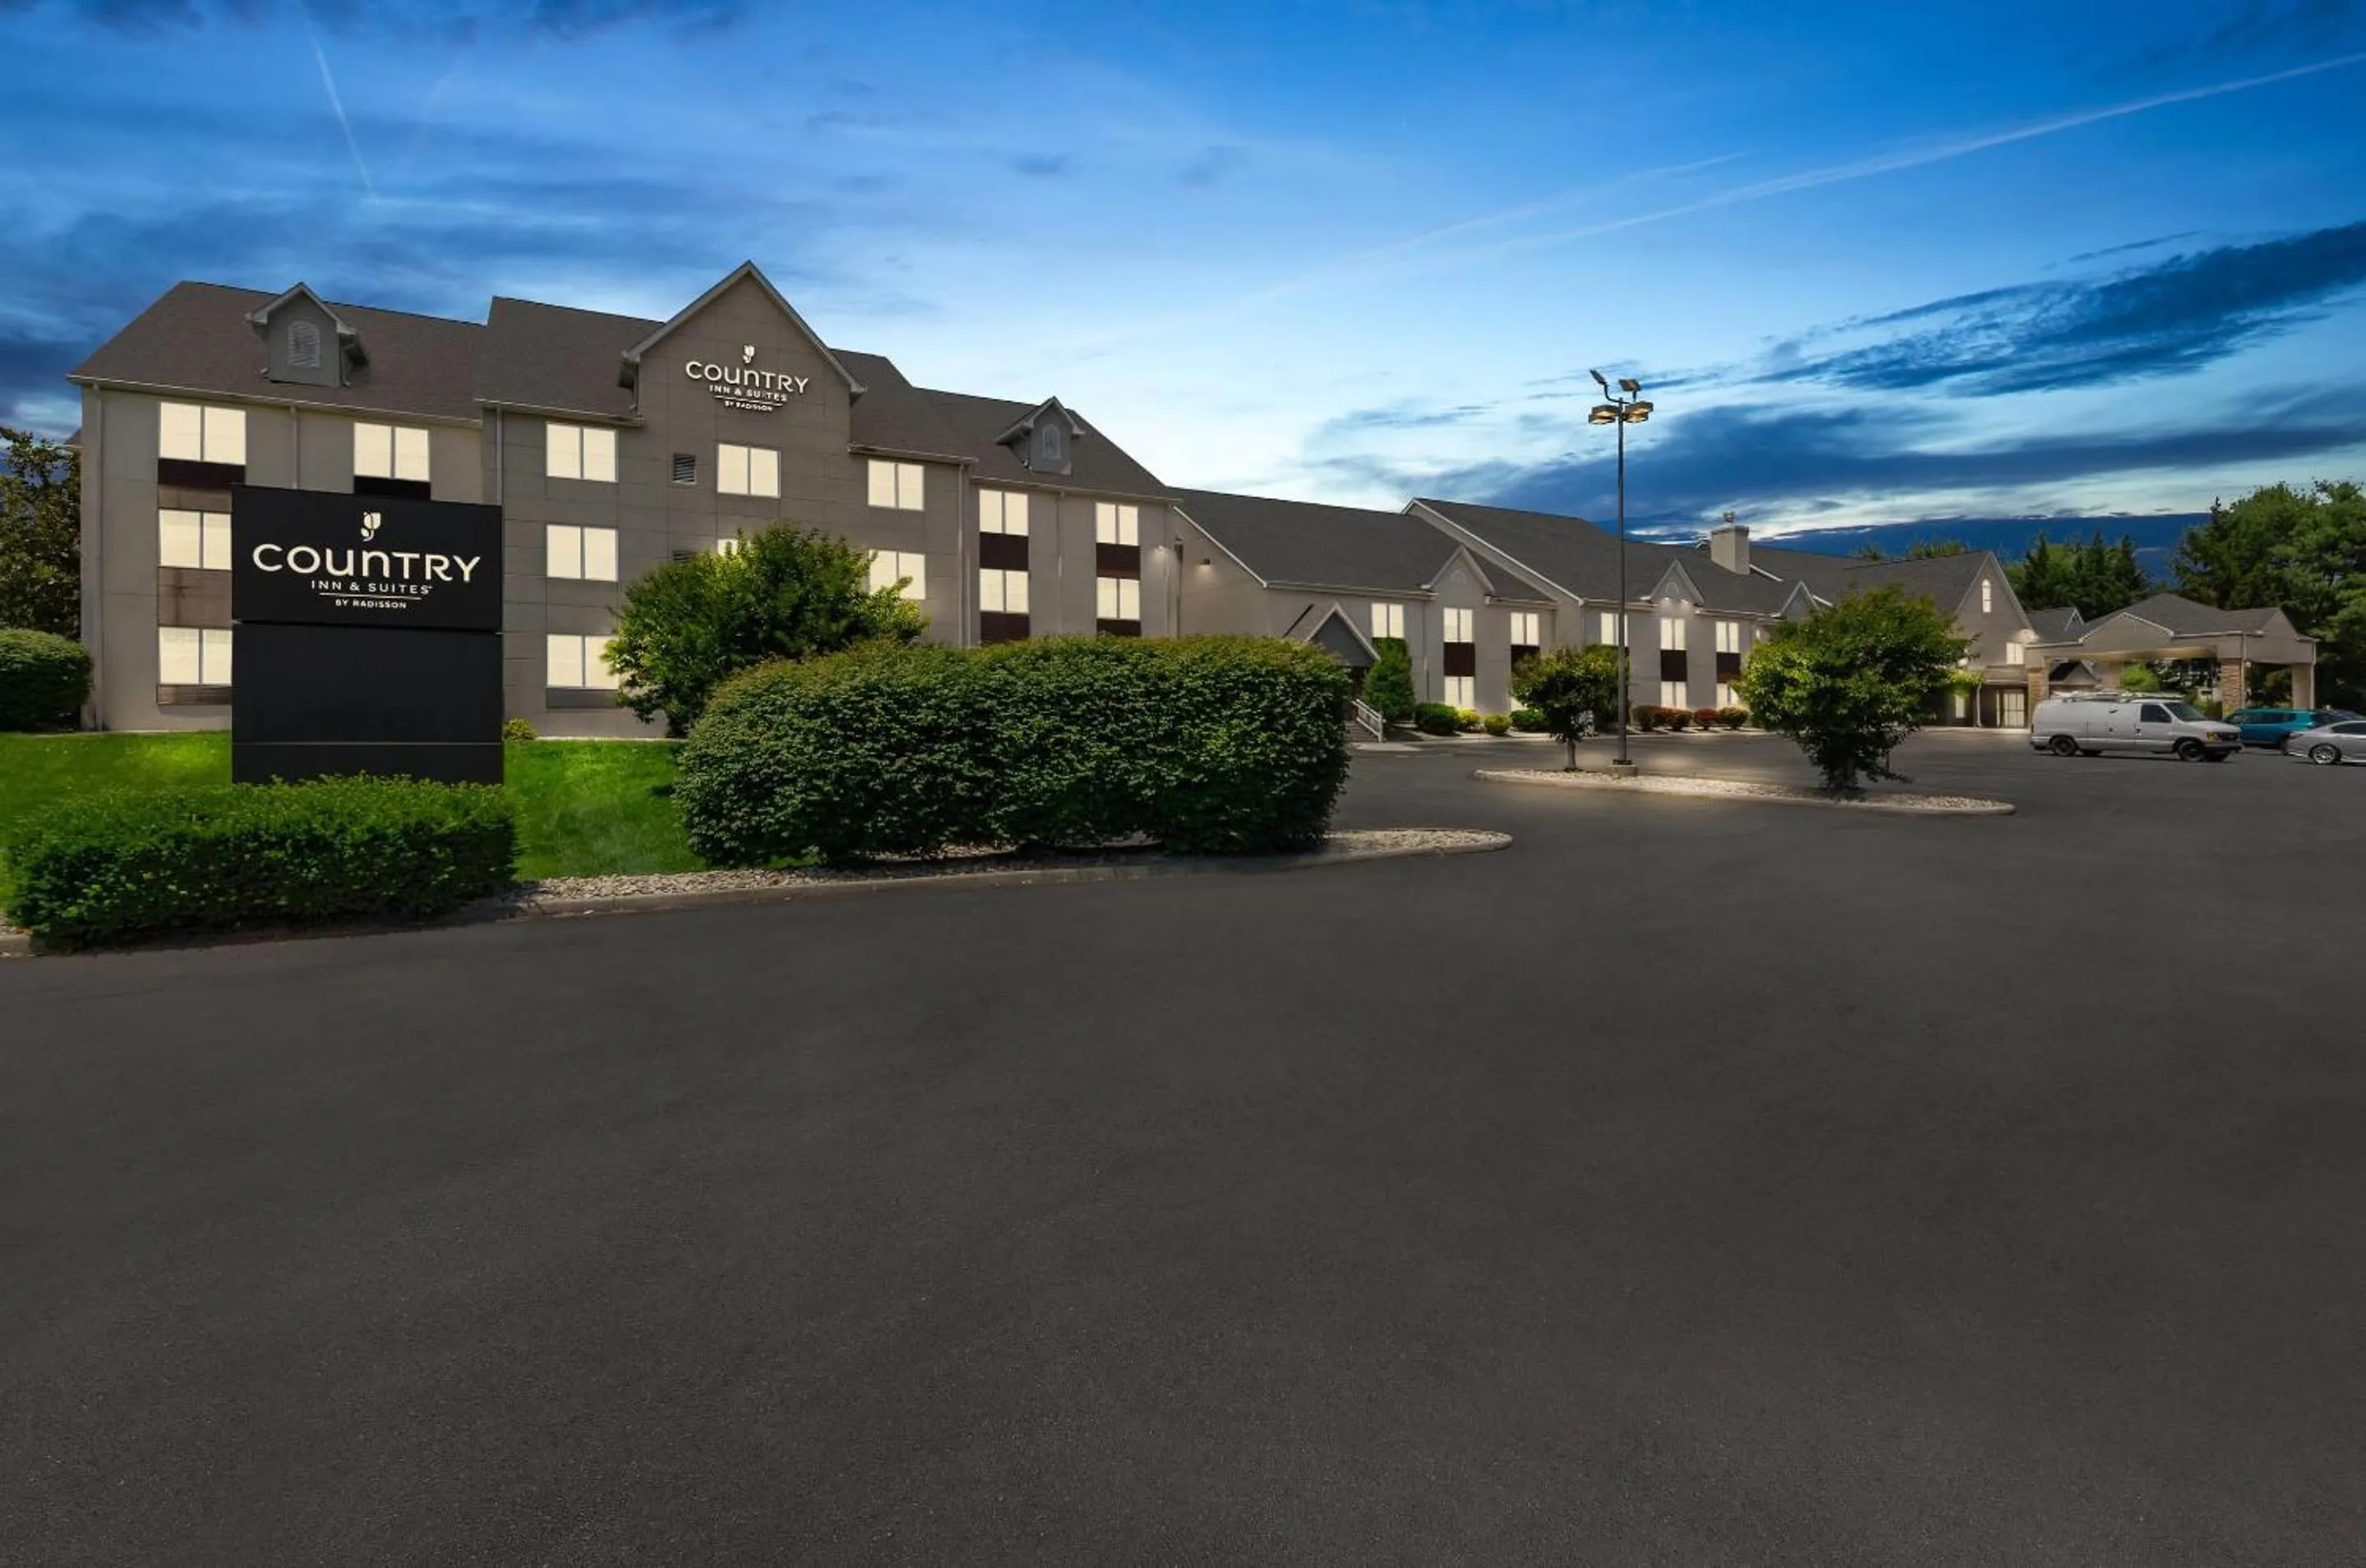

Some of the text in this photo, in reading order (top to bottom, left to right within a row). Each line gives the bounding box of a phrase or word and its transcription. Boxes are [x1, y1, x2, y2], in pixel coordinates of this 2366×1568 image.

[709, 385, 730, 394] INN
[746, 389, 788, 401] SUITES
[311, 580, 430, 594] INN & SUITES
[335, 599, 407, 609] BY RADISSON
